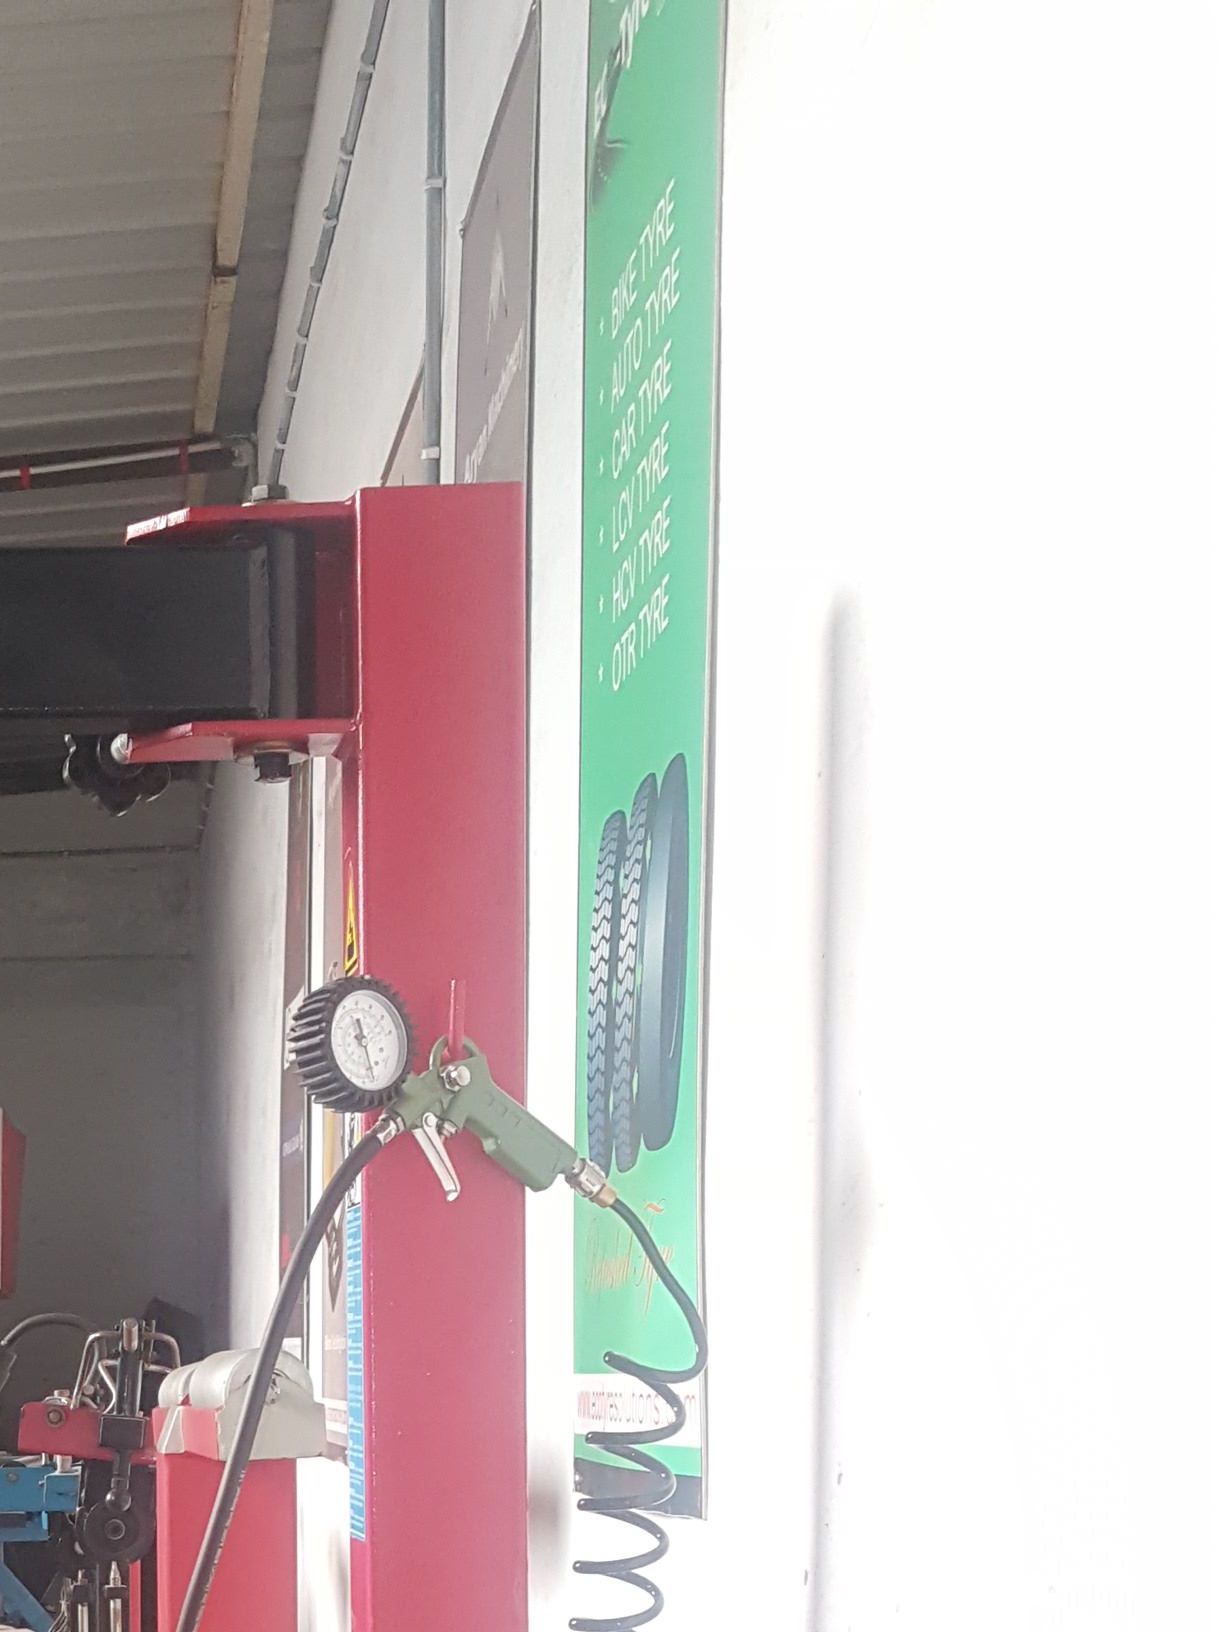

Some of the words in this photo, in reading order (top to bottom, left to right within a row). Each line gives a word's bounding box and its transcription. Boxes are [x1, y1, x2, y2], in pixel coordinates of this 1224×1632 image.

[612, 248, 638, 340] BIKE
[639, 177, 675, 282] TYRE
[611, 317, 643, 414] AUTO
[645, 246, 680, 348] TYRE
[612, 402, 637, 480] CAR
[638, 338, 672, 436] TYRE
[612, 475, 635, 554] LCV
[637, 420, 670, 513] TYRE
[612, 546, 637, 624] HCV
[639, 494, 671, 585] TYRE
[612, 622, 637, 692] OTR
[639, 573, 670, 659] TYRE
